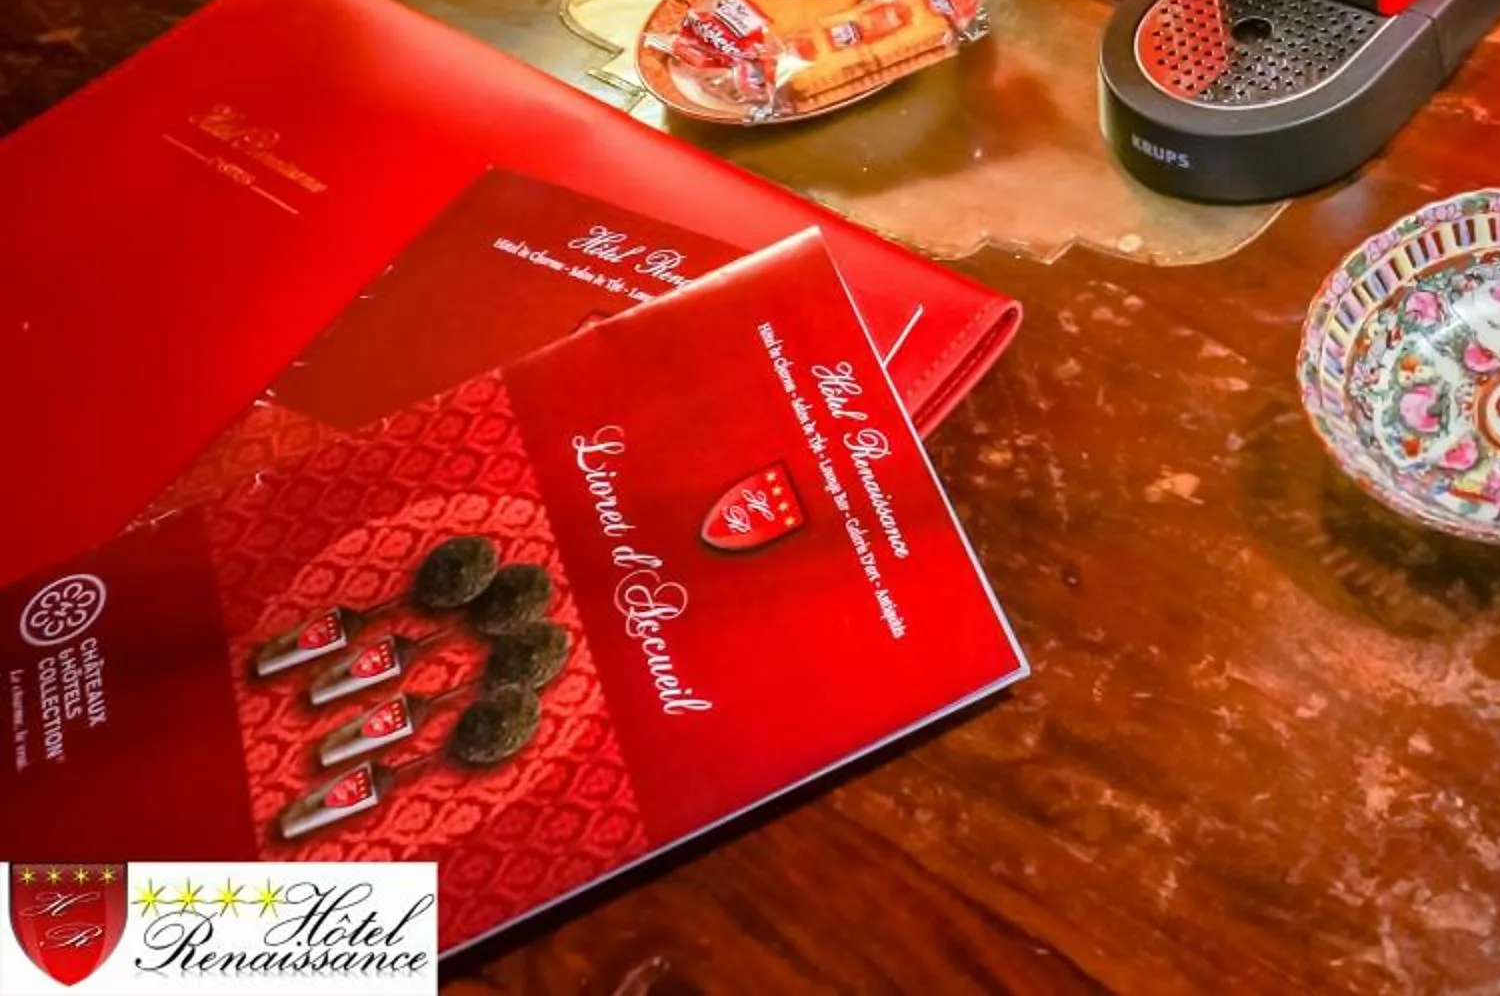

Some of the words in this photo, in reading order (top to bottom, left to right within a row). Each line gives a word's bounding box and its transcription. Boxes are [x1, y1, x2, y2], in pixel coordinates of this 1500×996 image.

[1131, 133, 1190, 169] KRUPS
[811, 361, 868, 421] Hôtel
[843, 429, 910, 559] Renaissance
[38, 657, 64, 760] COLLECTION
[80, 636, 107, 728] CHÂTEAUX
